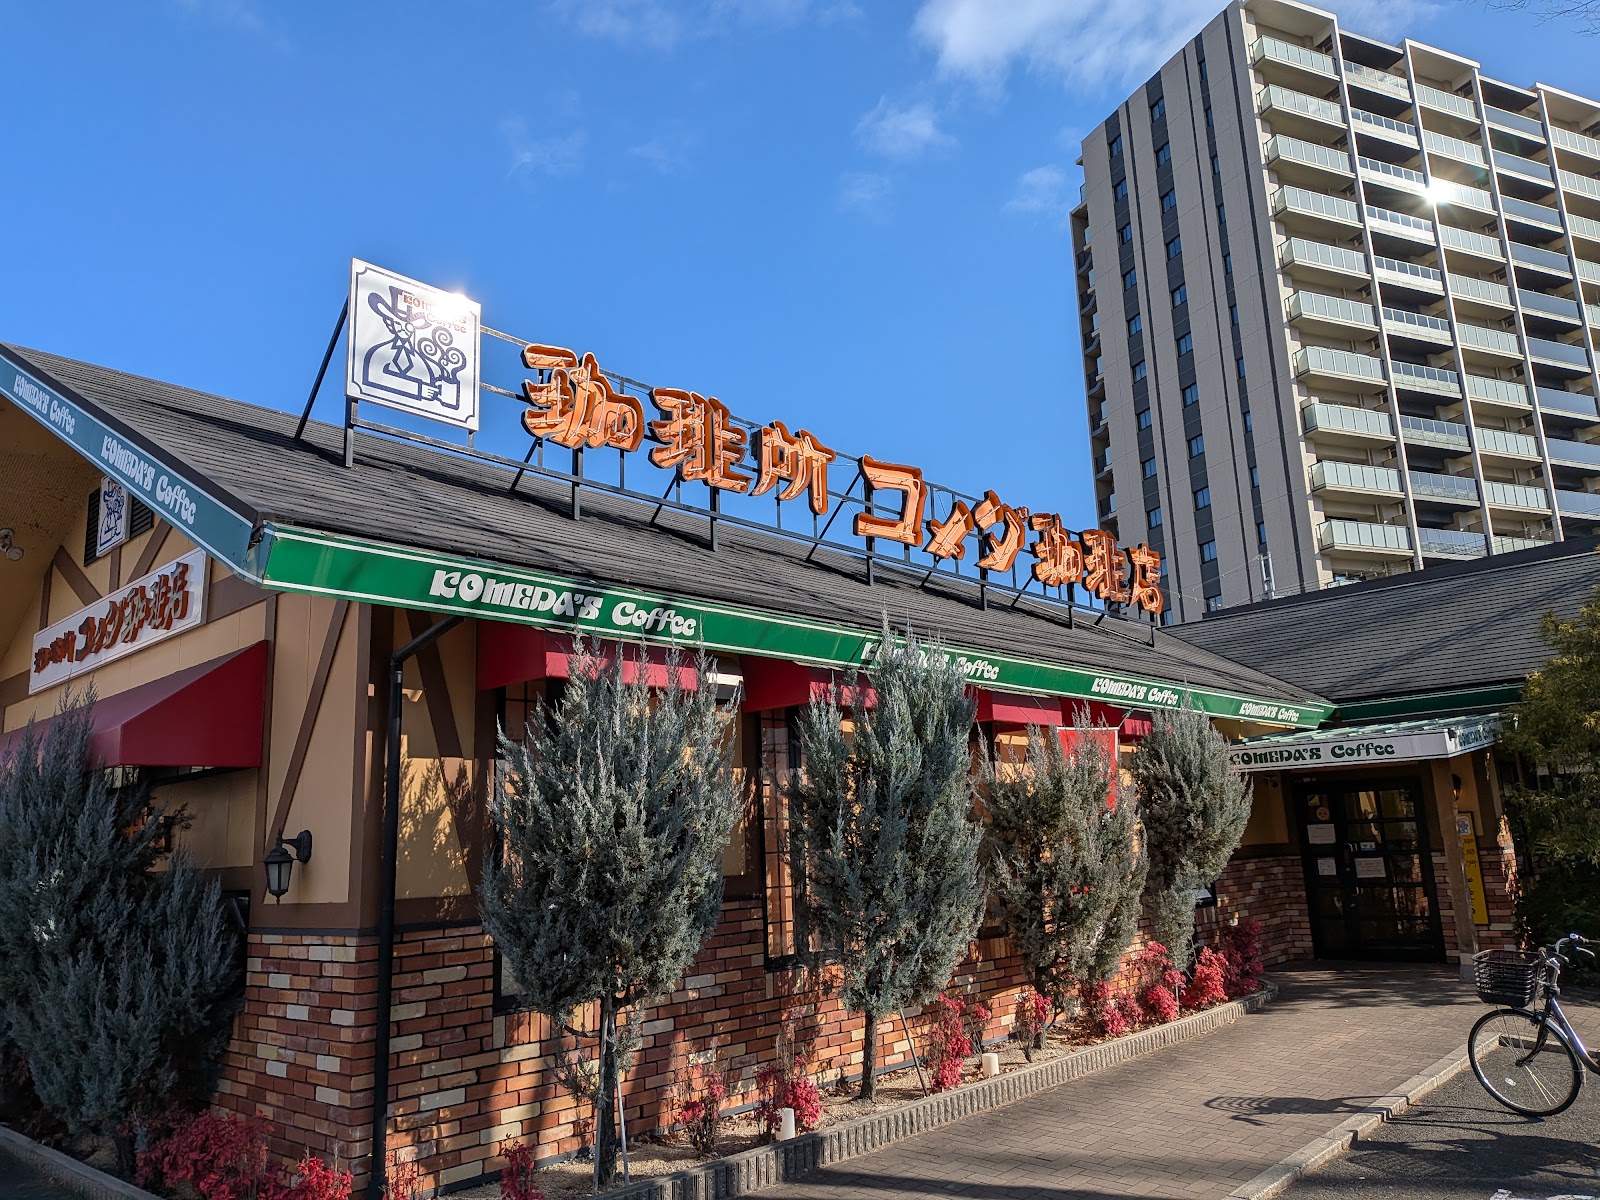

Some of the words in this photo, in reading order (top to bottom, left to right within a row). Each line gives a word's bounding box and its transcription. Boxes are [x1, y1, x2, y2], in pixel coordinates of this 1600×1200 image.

[49, 399, 76, 435] Coffee
[100, 434, 156, 492] KOMEDA'S
[155, 474, 197, 525] Coffee
[429, 569, 604, 621] KOMEDA'S
[611, 601, 697, 637] Coffee
[1091, 677, 1148, 700] KOMEDA'S
[1147, 687, 1179, 706] Coffee
[1330, 742, 1396, 759] Coffee
